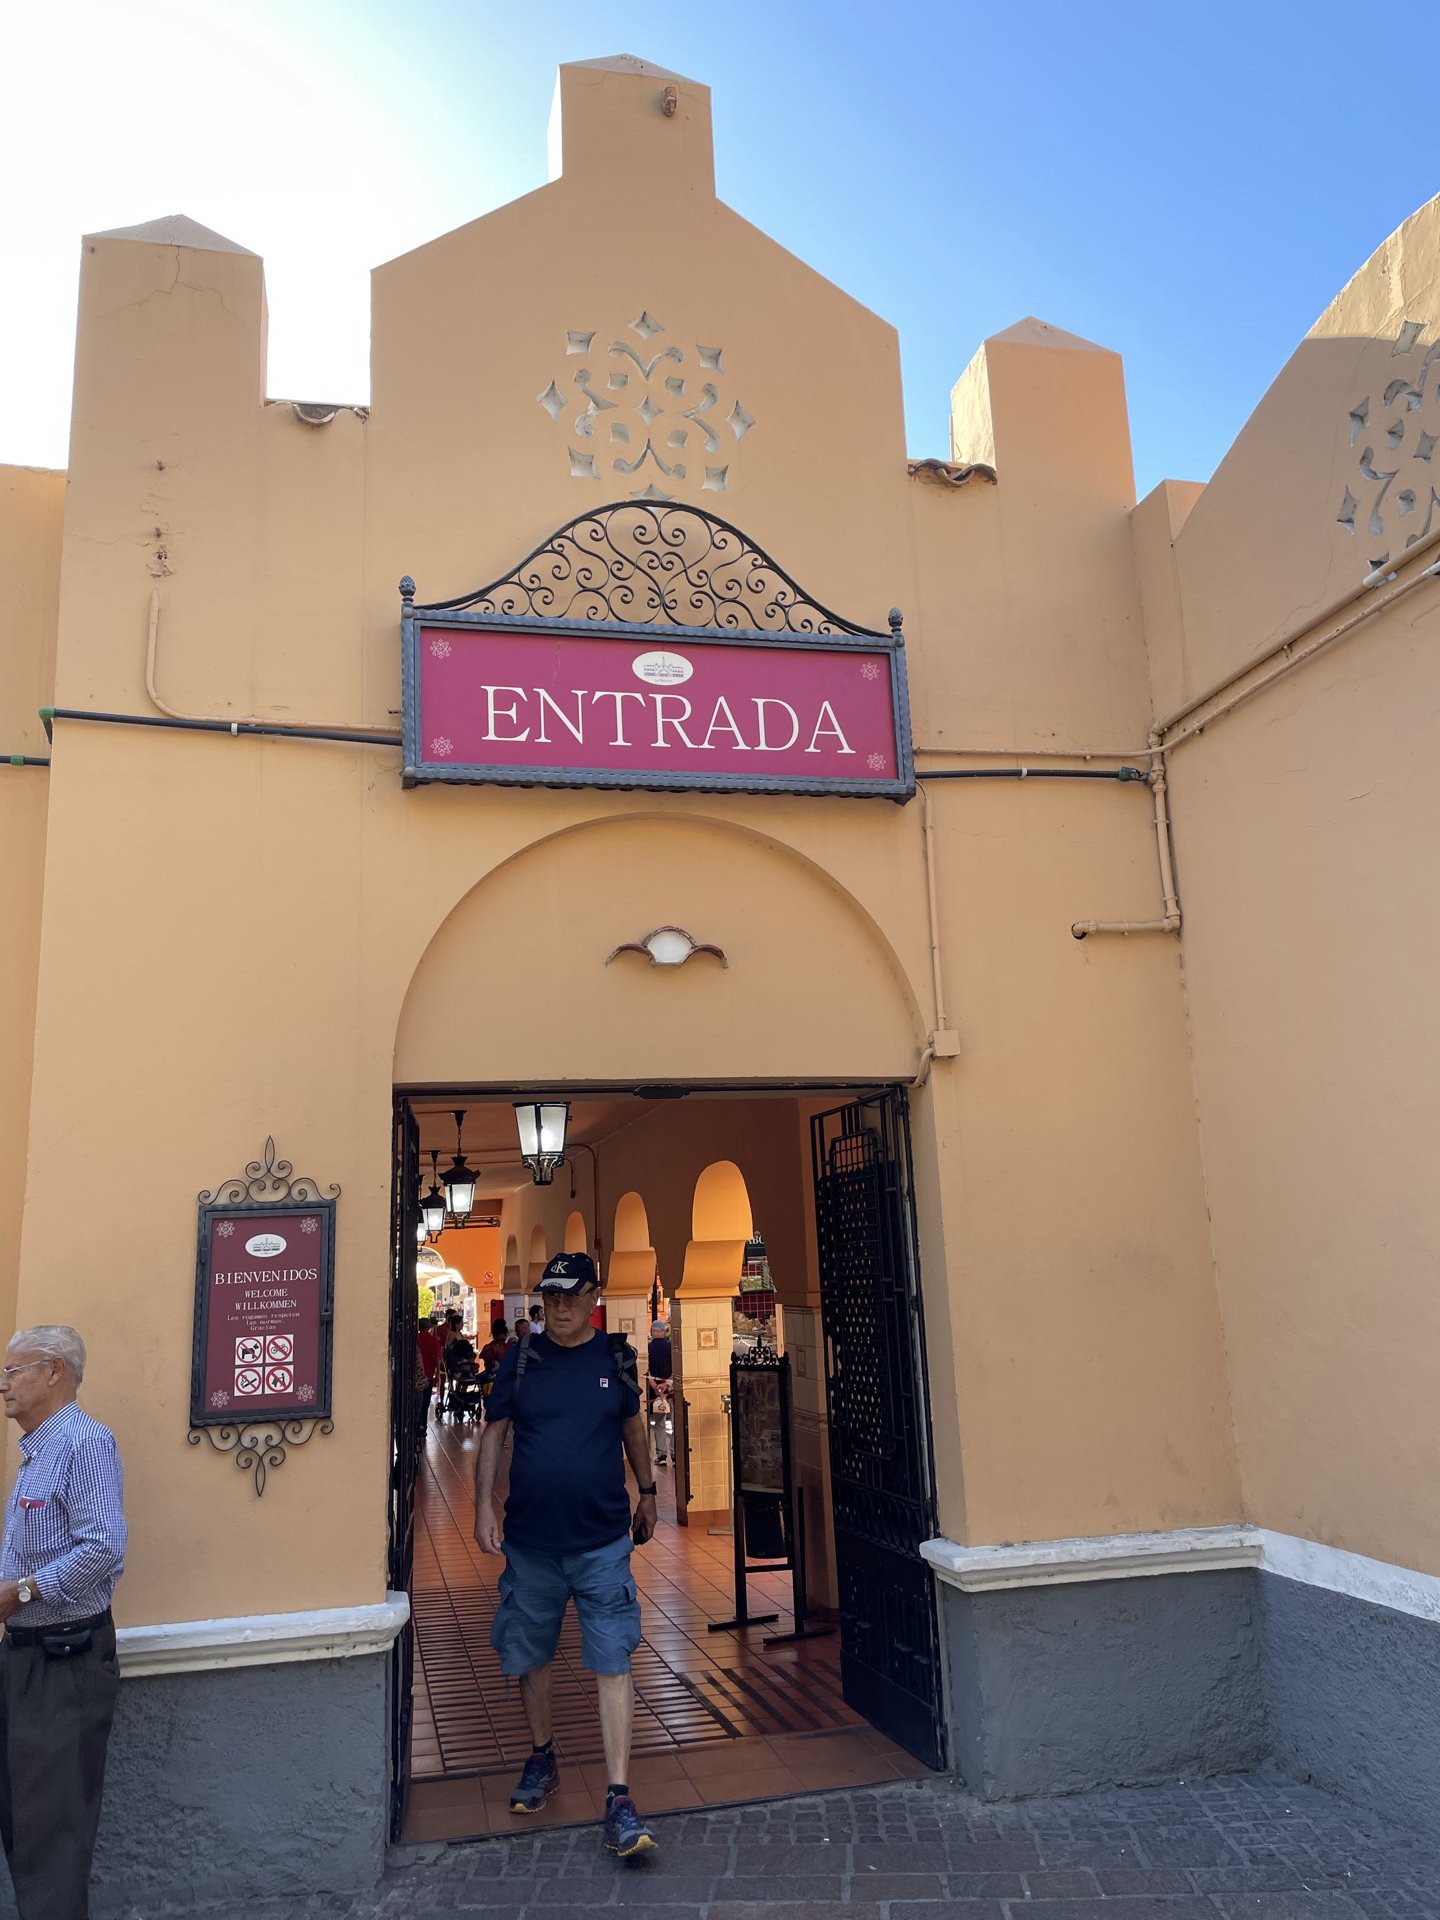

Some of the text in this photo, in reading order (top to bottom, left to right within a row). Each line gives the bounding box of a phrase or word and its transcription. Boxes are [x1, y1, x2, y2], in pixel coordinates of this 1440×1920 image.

[481, 685, 856, 754] ENTRADA
[215, 1268, 317, 1285] BIENVENIDOS
[244, 1288, 288, 1298] WELCOME
[234, 1299, 297, 1311] WILLKOMMEN
